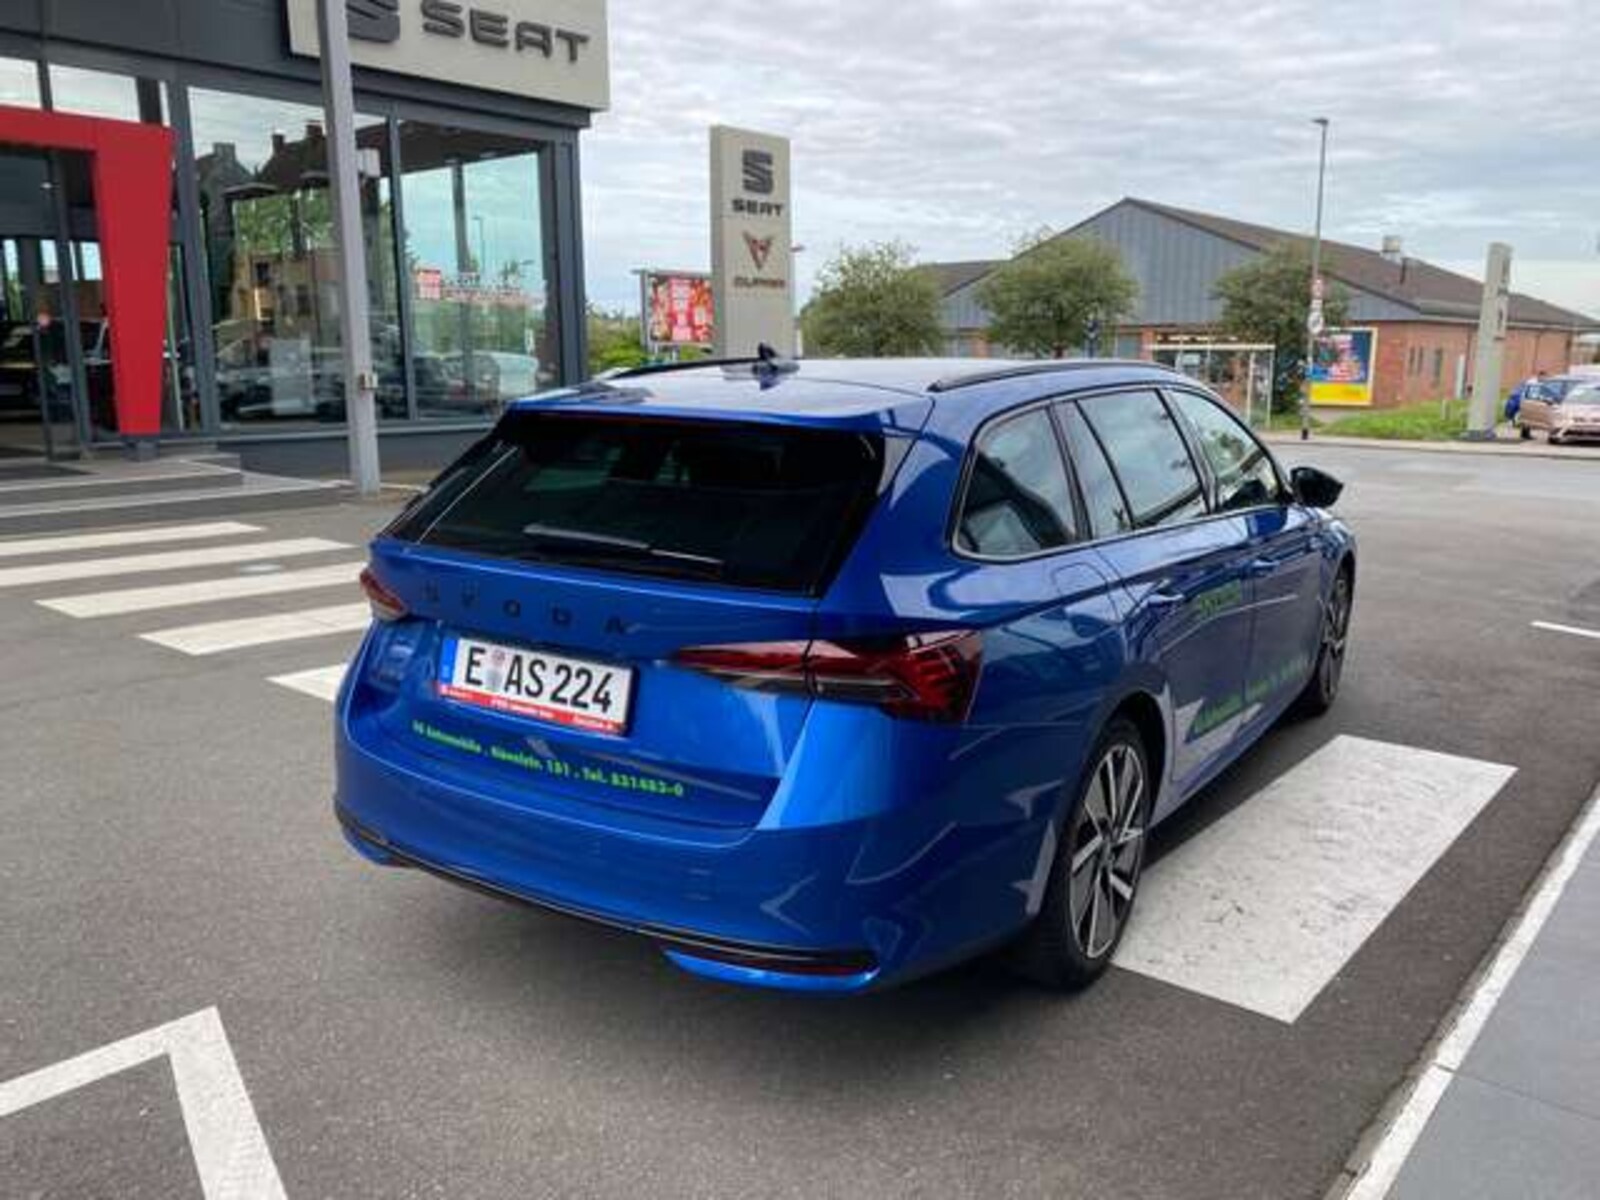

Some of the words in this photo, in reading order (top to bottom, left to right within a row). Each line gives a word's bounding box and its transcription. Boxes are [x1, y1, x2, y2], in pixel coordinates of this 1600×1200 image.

[420, 0, 590, 62] SEAT
[732, 198, 784, 216] SEAT
[464, 646, 486, 687] E
